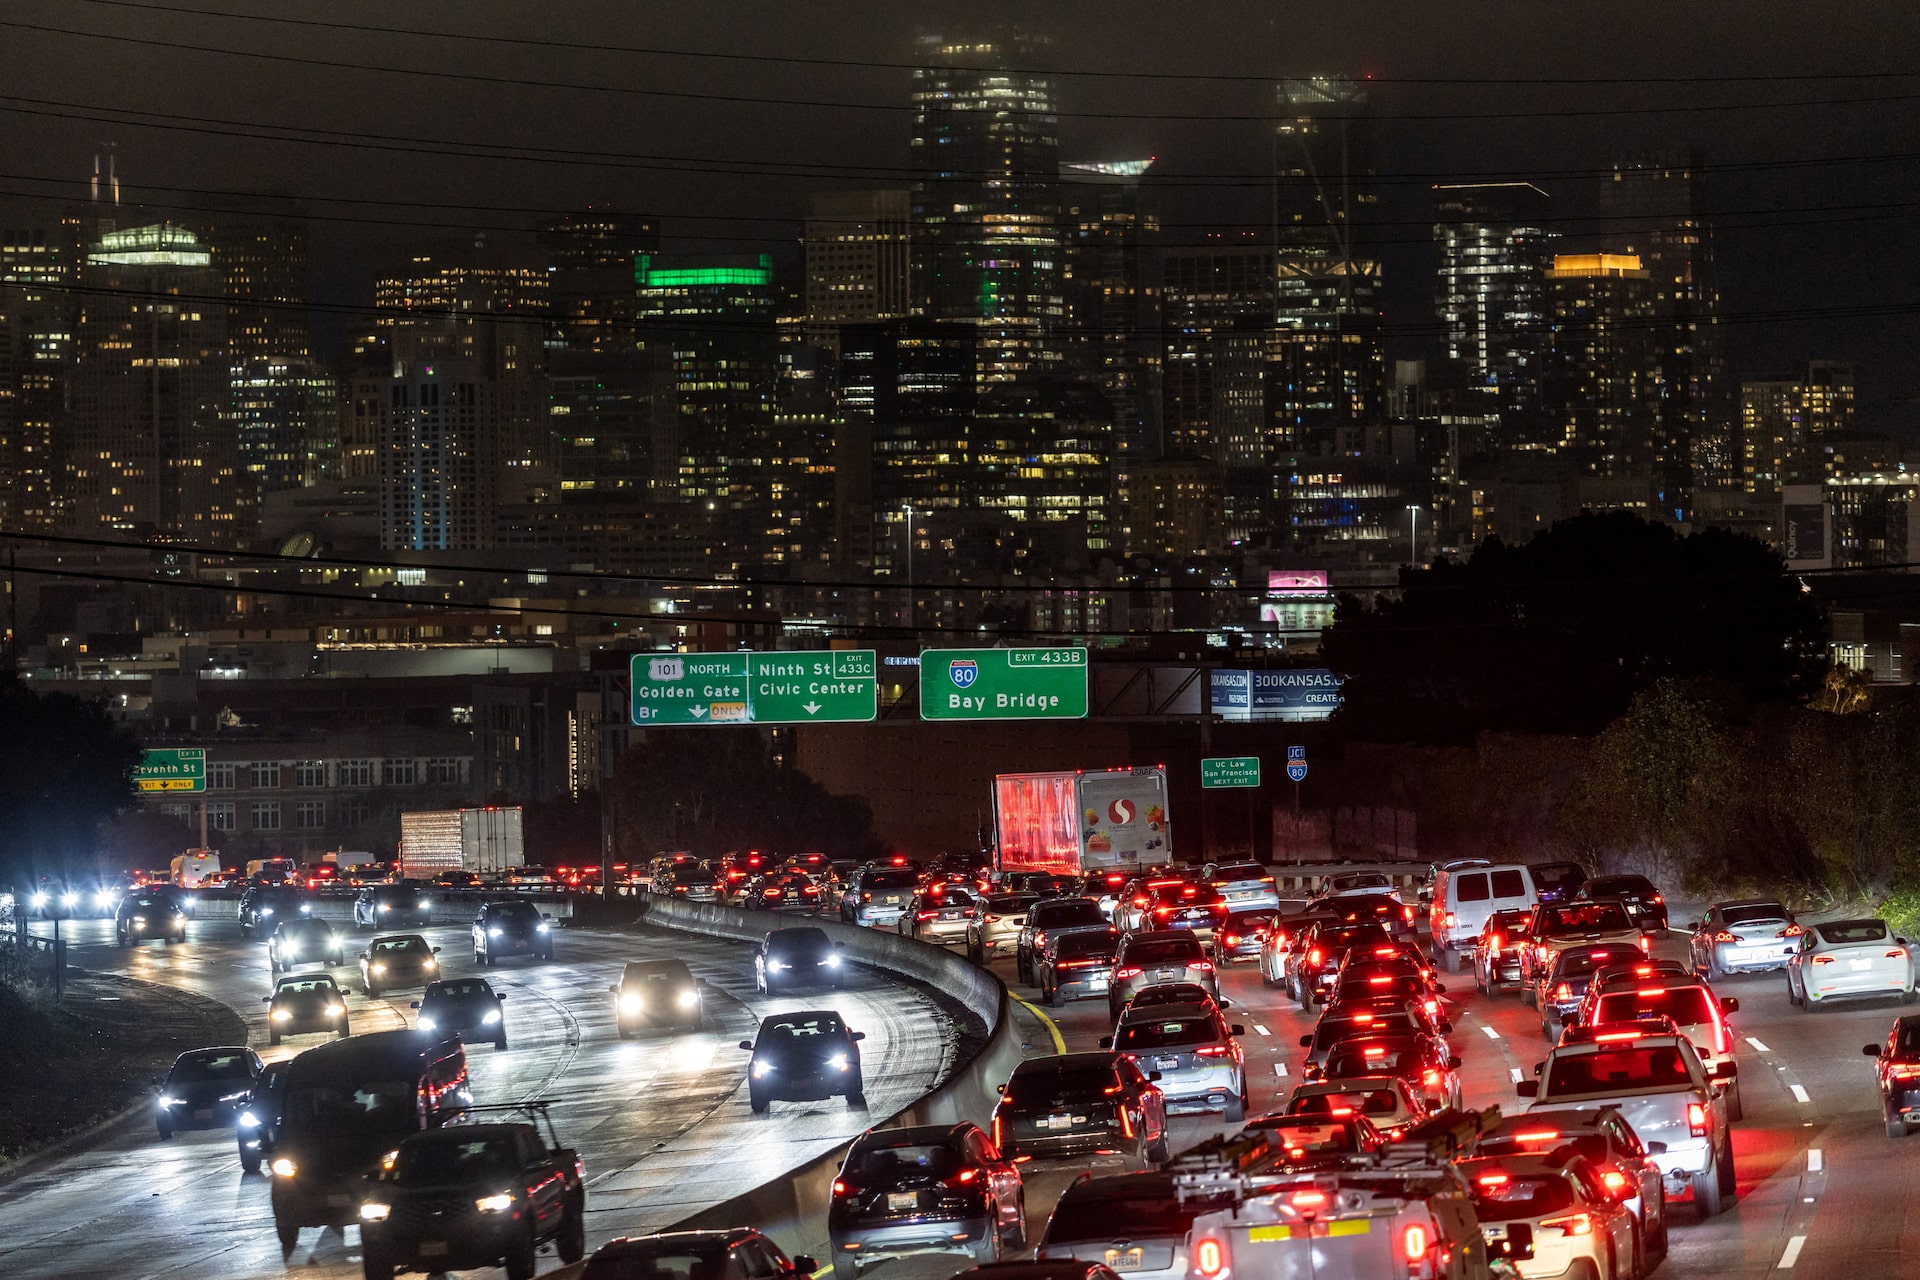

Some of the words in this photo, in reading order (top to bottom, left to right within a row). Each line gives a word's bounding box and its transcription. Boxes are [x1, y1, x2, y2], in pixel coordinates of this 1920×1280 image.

[1787, 520, 1798, 559] Quincy
[1015, 653, 1036, 662] EXIT
[1041, 652, 1081, 663] 433B
[657, 664, 676, 675] 101
[689, 664, 730, 674] NORTH
[759, 664, 804, 676] Ninth
[813, 663, 831, 675] St
[838, 664, 871, 673] 433C
[954, 669, 974, 683] 80
[639, 686, 695, 698] Golden
[703, 685, 740, 697] Gate
[759, 683, 801, 695] Civic
[809, 682, 864, 695] Center
[949, 694, 986, 711] Bay
[996, 693, 1059, 710] Bridge
[1305, 694, 1337, 703] CREATE
[639, 706, 658, 718] Br
[712, 706, 744, 716] ONLY
[1290, 748, 1304, 758] JCT
[183, 764, 196, 773] St
[1291, 768, 1303, 777] 80
